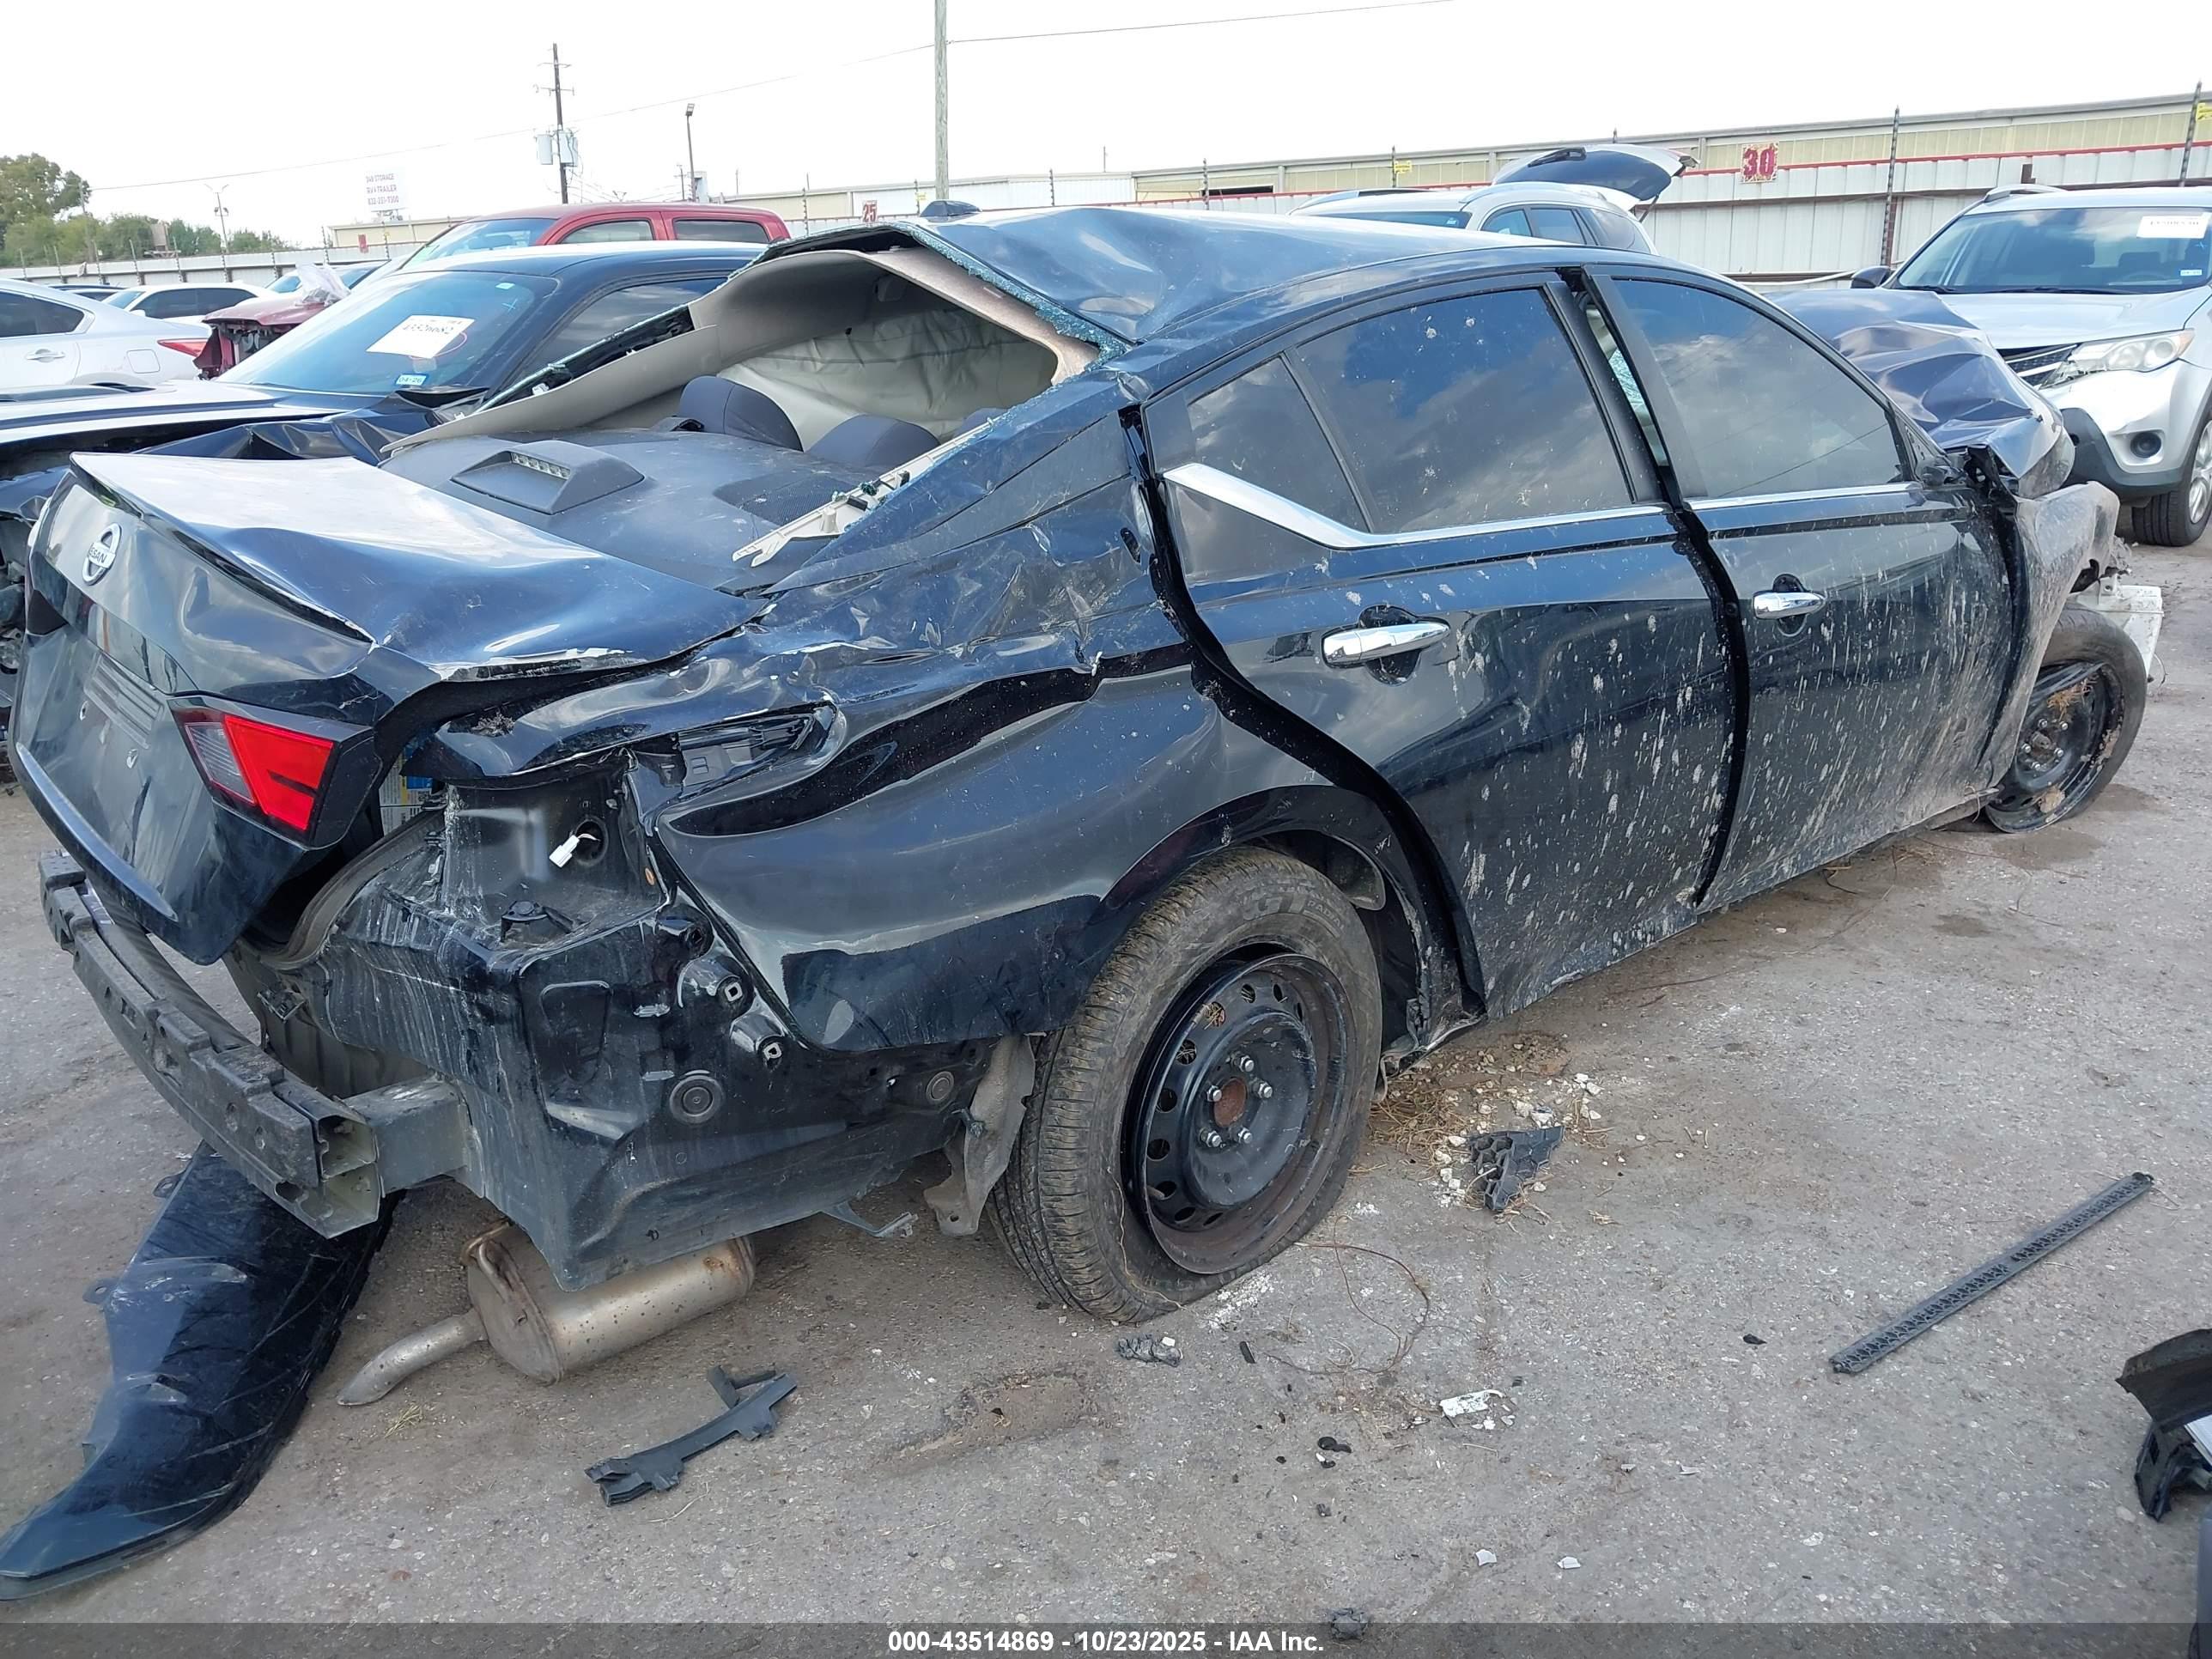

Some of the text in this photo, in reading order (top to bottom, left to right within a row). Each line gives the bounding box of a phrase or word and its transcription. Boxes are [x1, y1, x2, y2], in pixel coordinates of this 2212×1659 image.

[1744, 149, 1775, 178] 30
[374, 173, 394, 182] STORAGE
[377, 184, 398, 193] TRAILER
[863, 204, 878, 222] 25
[1307, 899, 1346, 932] RADIAL
